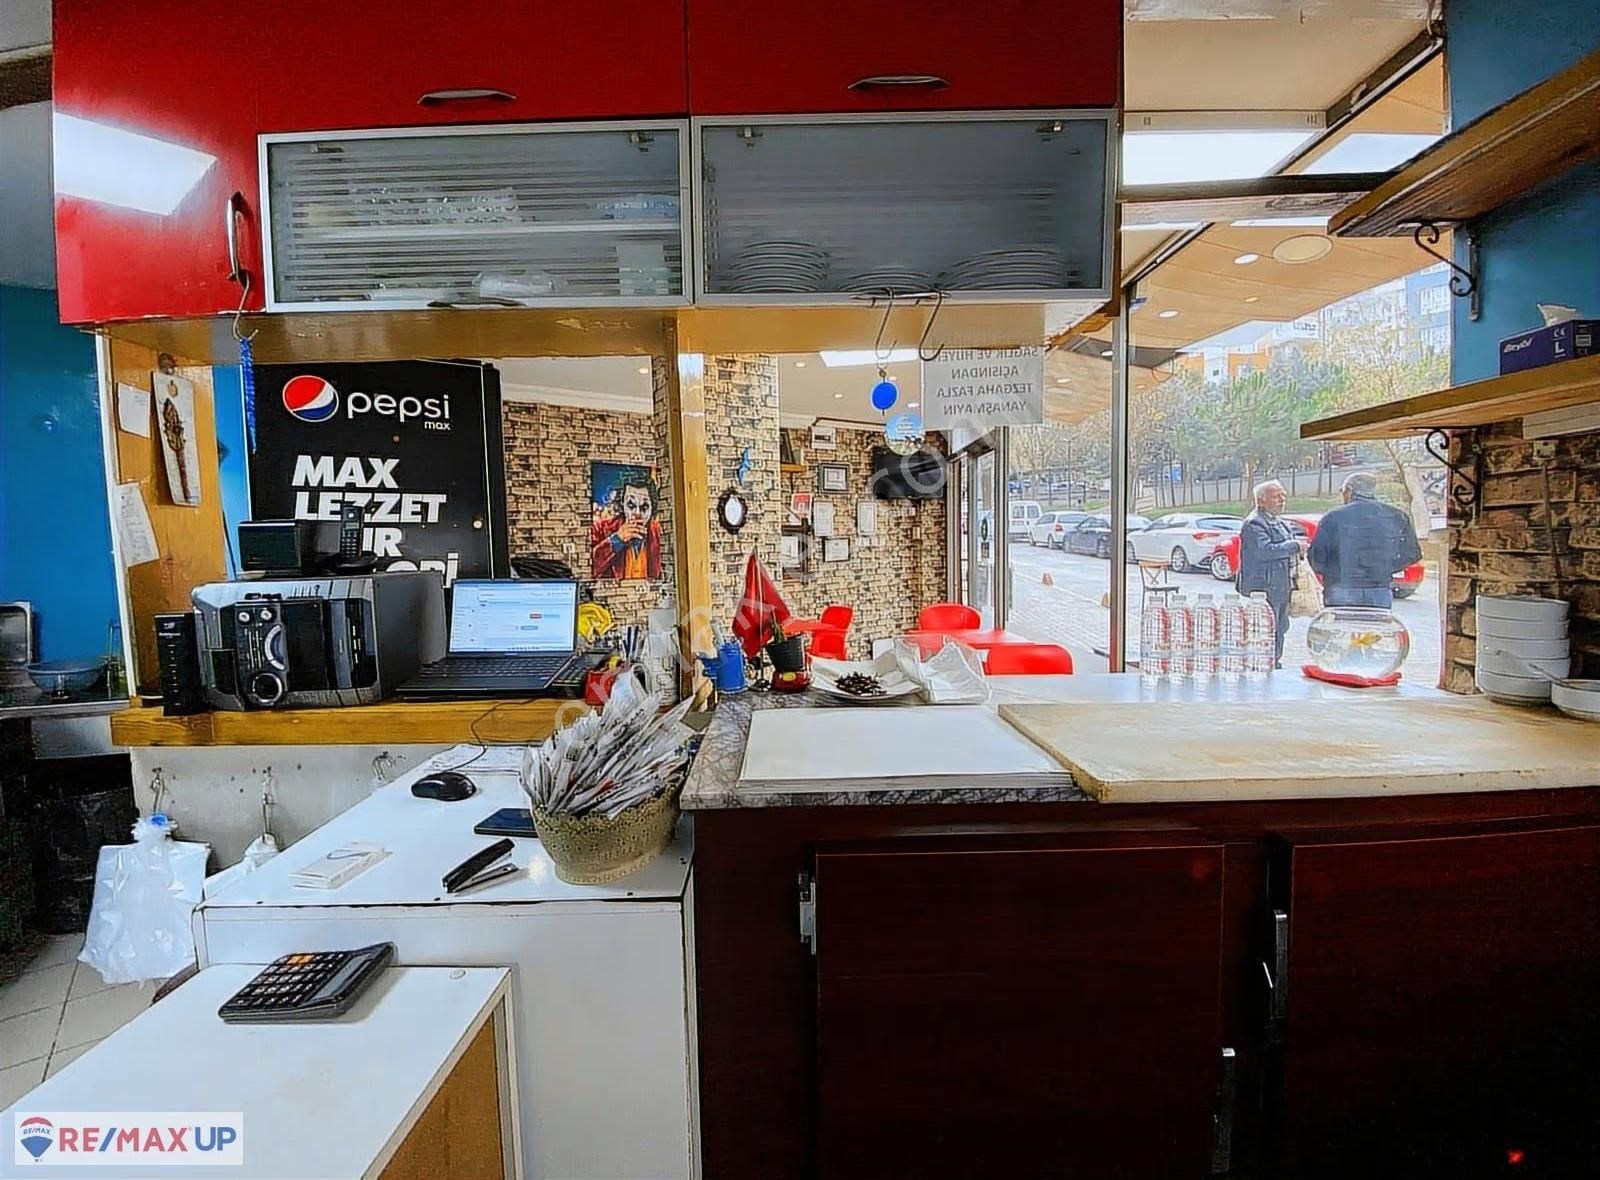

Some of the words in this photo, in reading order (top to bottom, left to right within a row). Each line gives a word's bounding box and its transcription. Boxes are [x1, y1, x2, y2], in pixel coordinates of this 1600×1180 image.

[347, 391, 450, 422] pepsi
[424, 420, 451, 431] max
[291, 455, 400, 489] MAX
